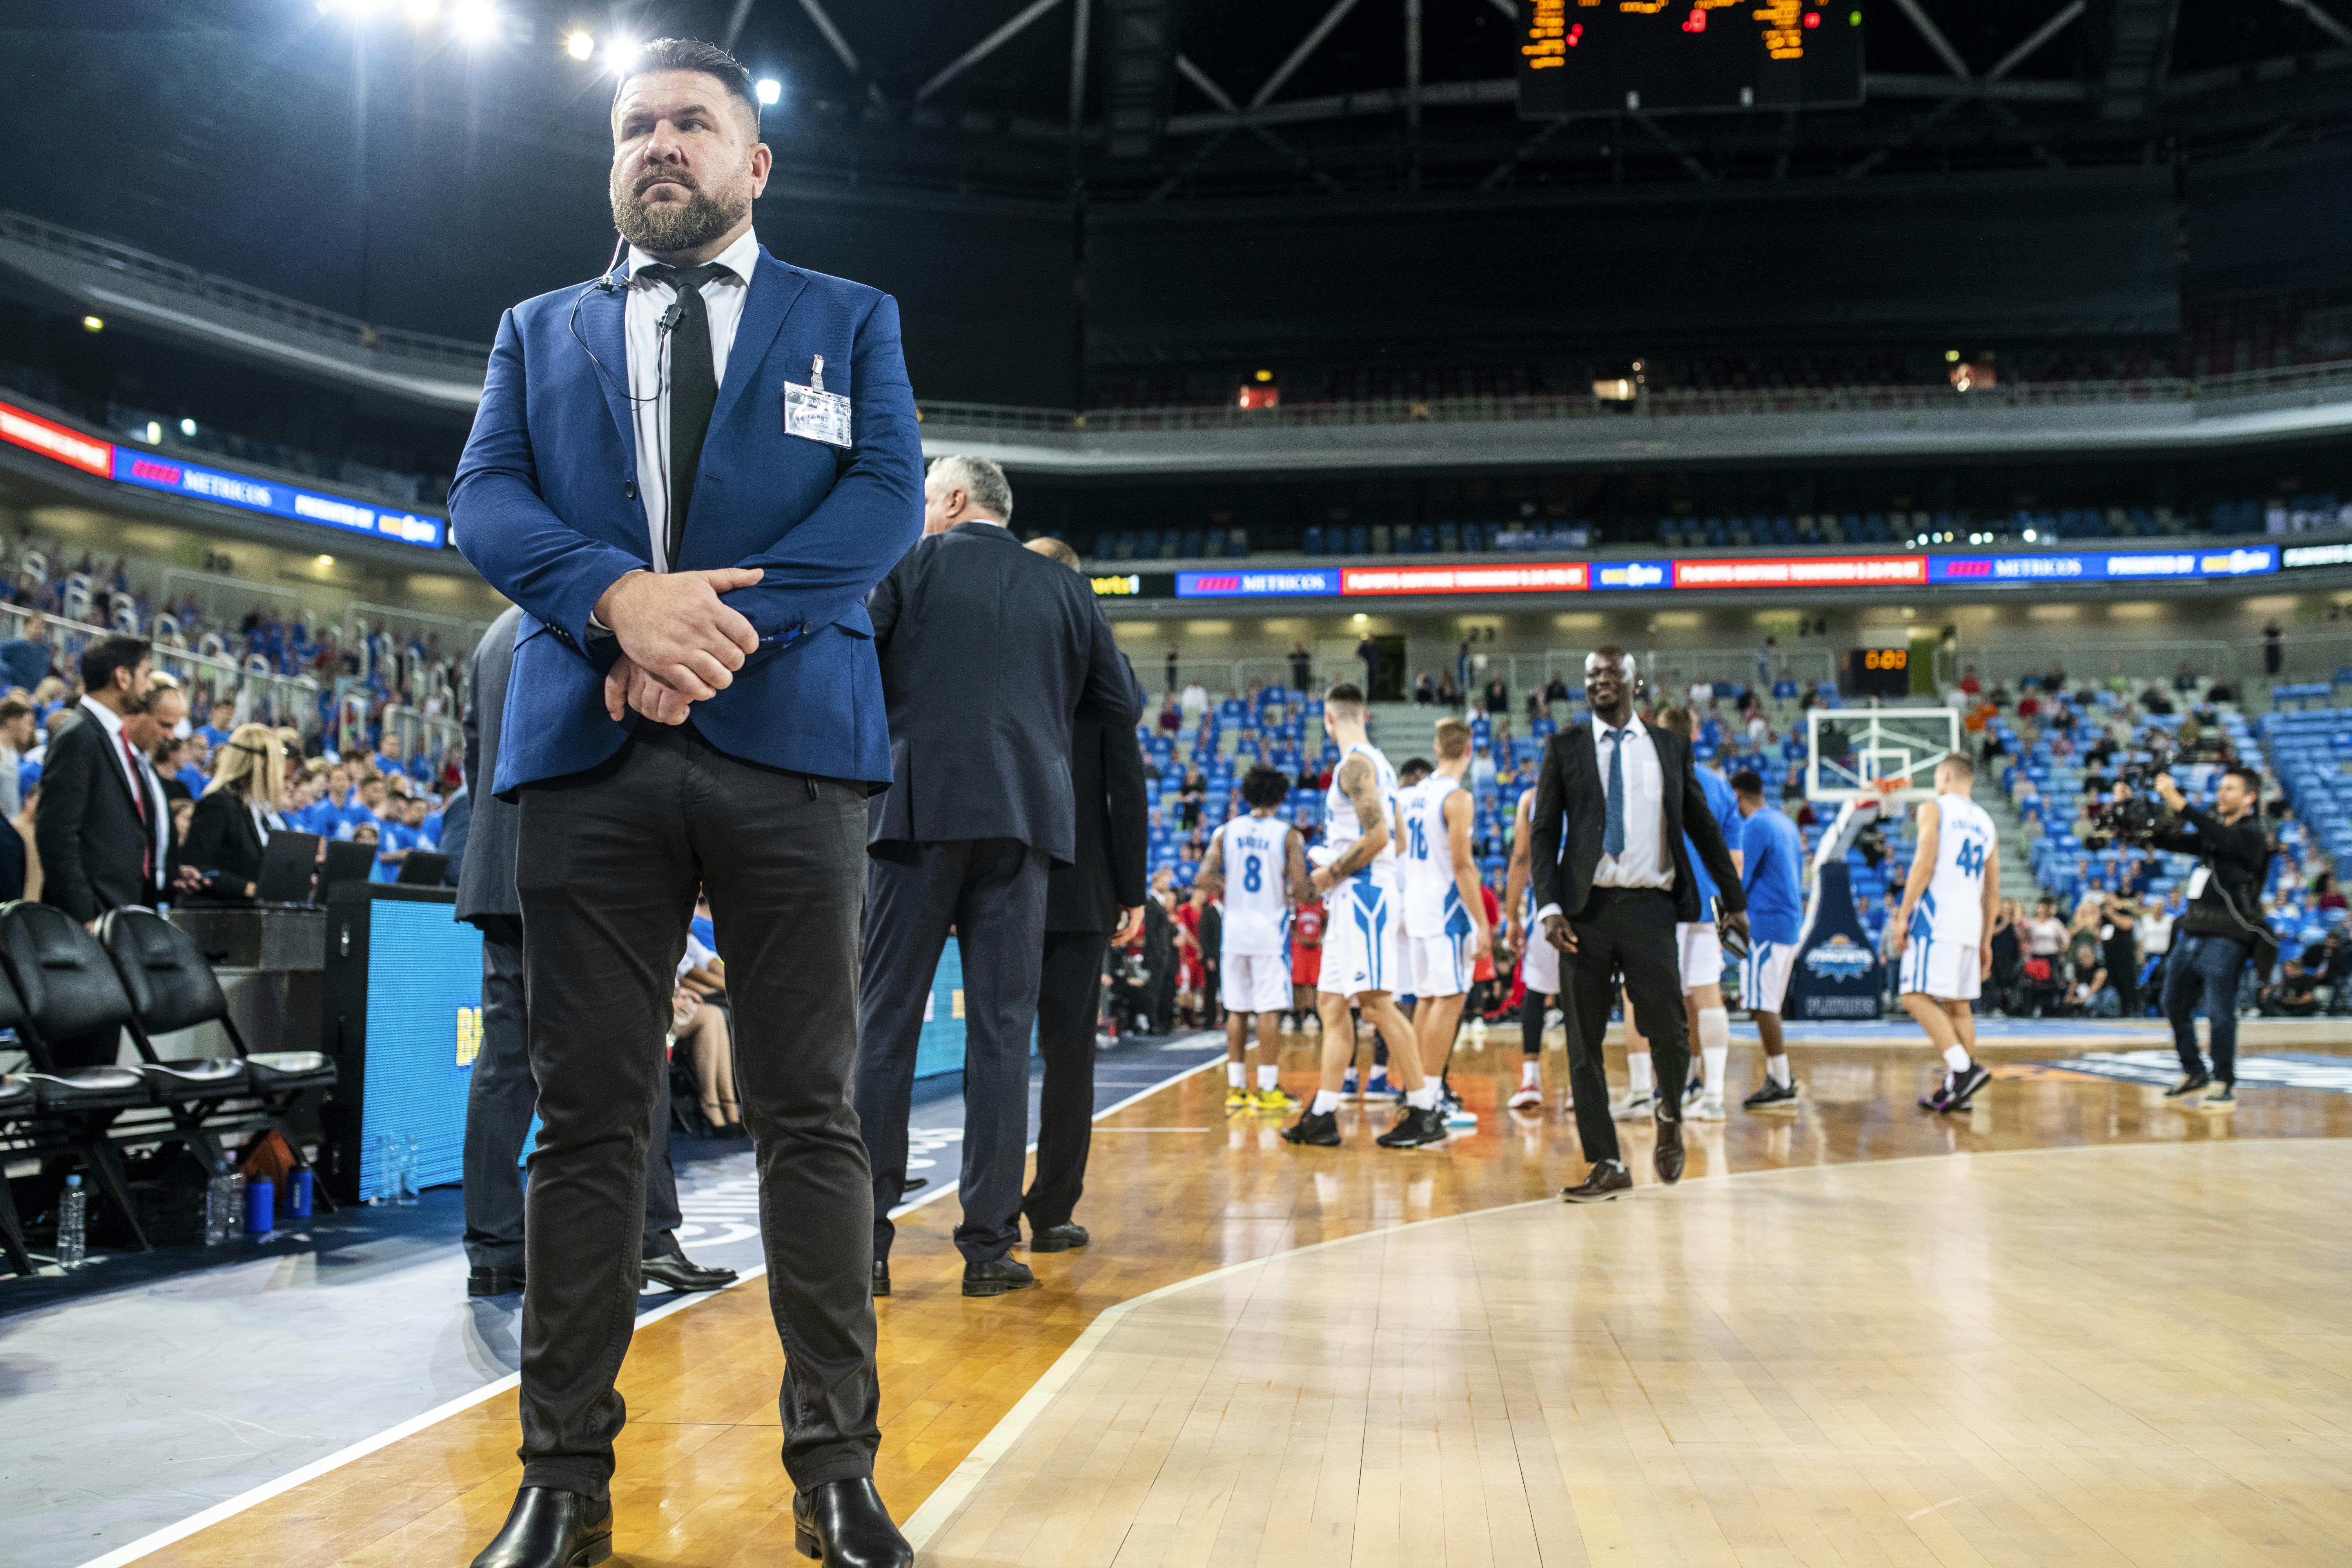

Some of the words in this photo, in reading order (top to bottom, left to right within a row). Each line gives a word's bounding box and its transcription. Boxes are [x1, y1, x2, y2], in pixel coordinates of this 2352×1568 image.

[1994, 557, 2082, 577] METRICOS
[1242, 573, 1326, 592] METRICOS
[1408, 816, 1428, 860] 16
[1244, 854, 1261, 893] 8
